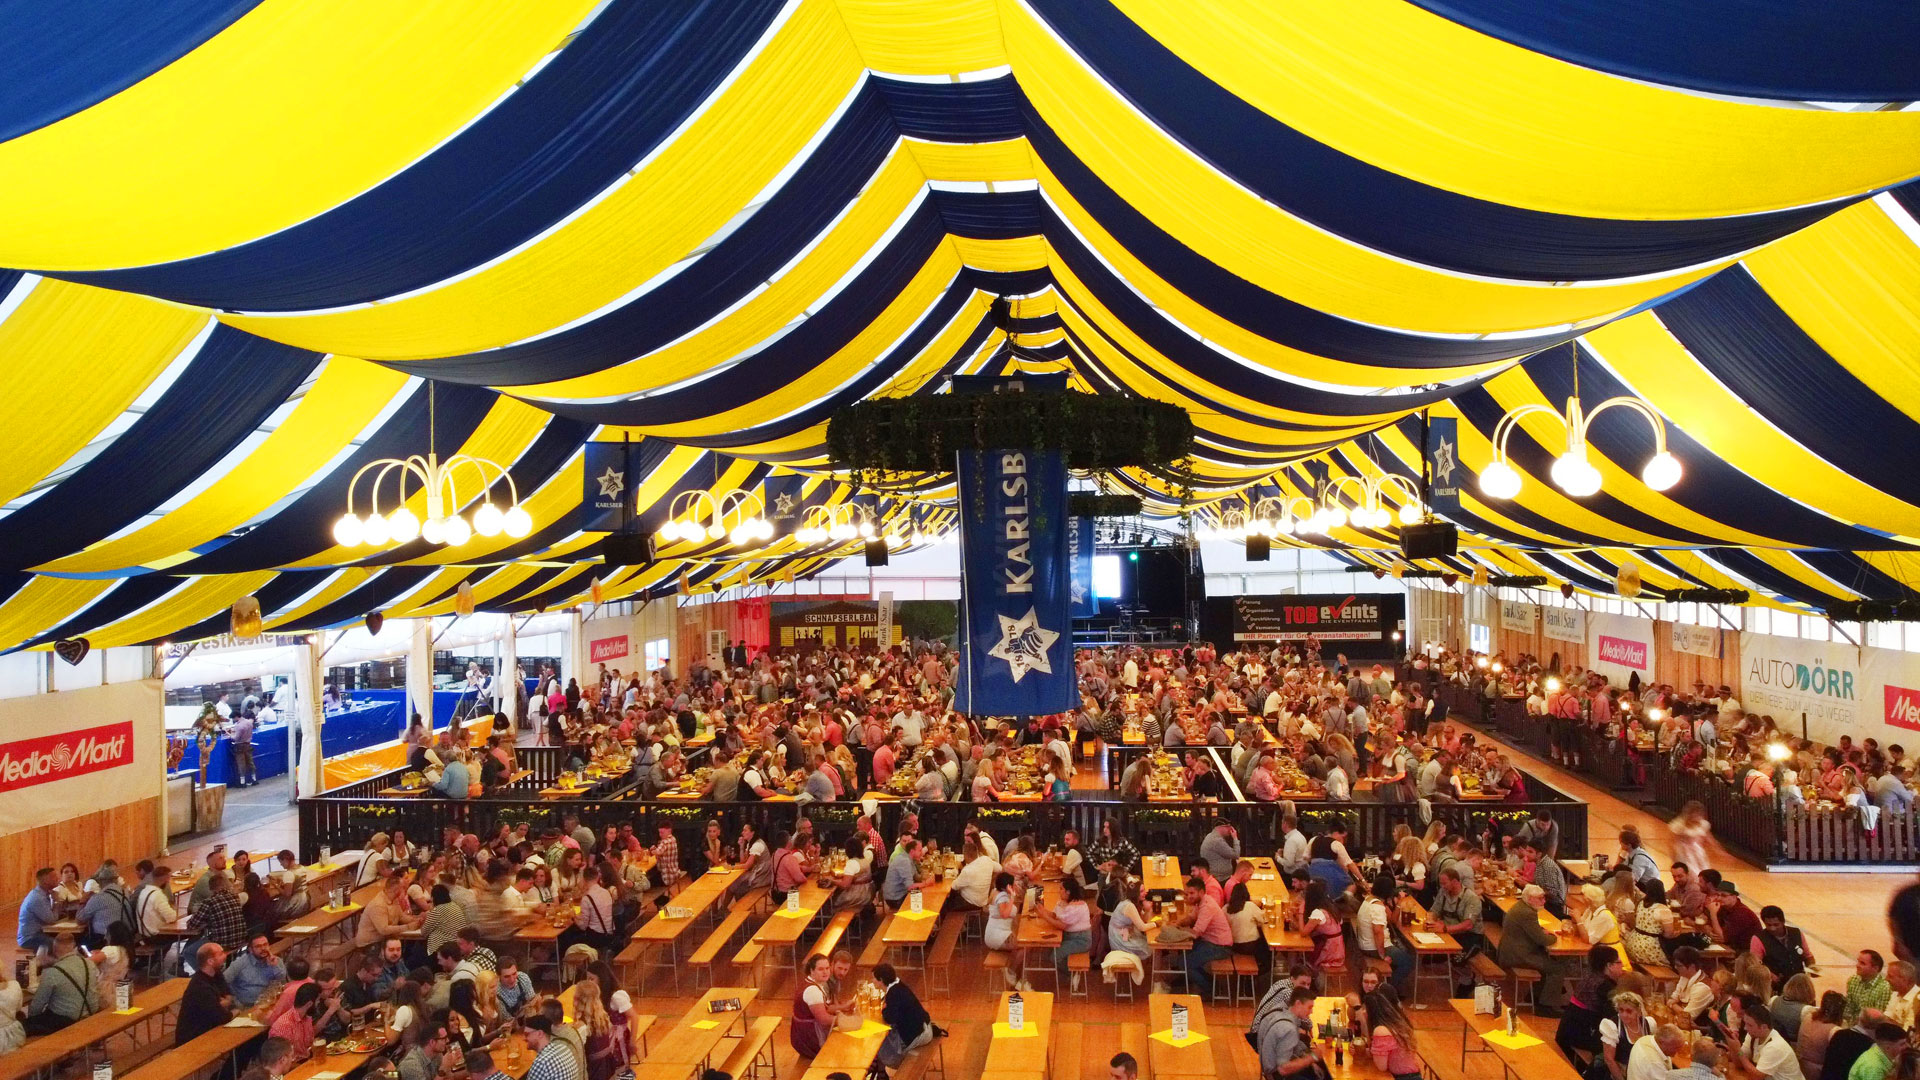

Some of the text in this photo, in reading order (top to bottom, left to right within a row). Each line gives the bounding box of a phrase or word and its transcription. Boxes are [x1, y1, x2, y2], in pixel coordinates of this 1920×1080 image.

[1002, 451, 1034, 594] KARLSB
[805, 613, 877, 623] SCHNAPSERLBAR
[1283, 595, 1378, 624] TOB events
[1296, 631, 1371, 640] Groveranstaltungen!
[1600, 641, 1620, 660] Media
[66, 735, 125, 770] Markt
